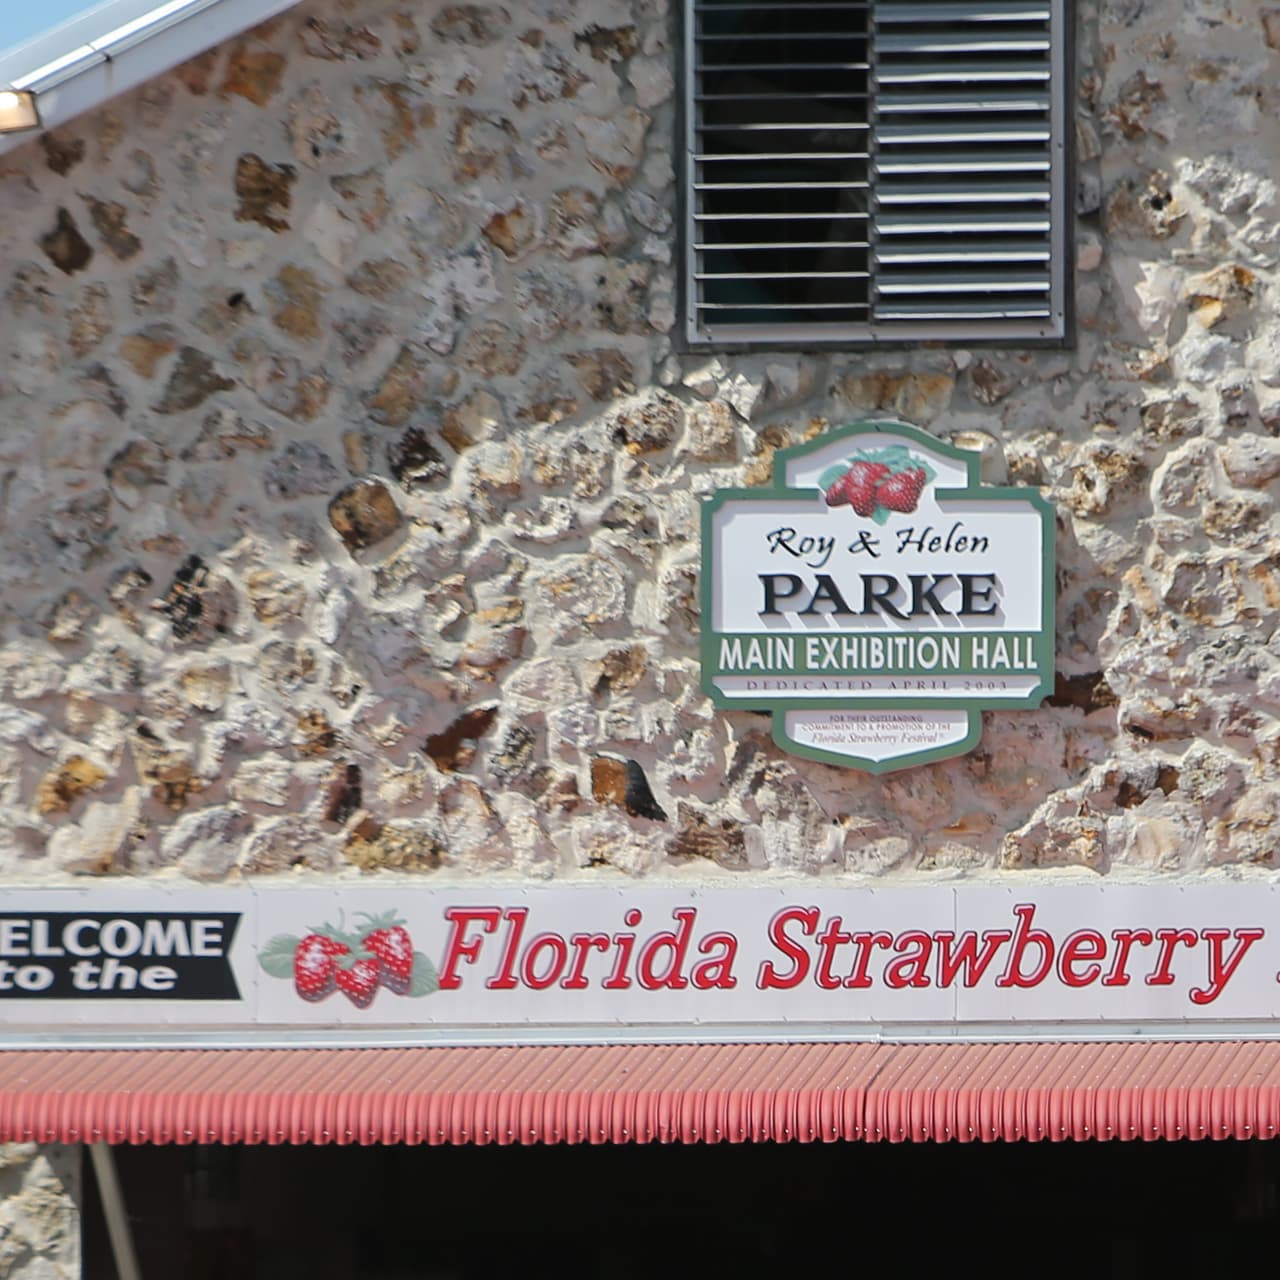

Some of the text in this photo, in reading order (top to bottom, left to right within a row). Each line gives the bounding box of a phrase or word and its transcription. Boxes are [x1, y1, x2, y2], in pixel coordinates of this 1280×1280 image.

[766, 521, 990, 569] Roy & Helen
[757, 572, 999, 621] PARKE
[719, 636, 1038, 671] MAIN EXHIBITION HALL
[746, 680, 1008, 691] DEDICATED APRIL 2003
[70, 958, 178, 990] the
[439, 905, 738, 992] Florida
[759, 903, 1264, 1004] Strawberry
